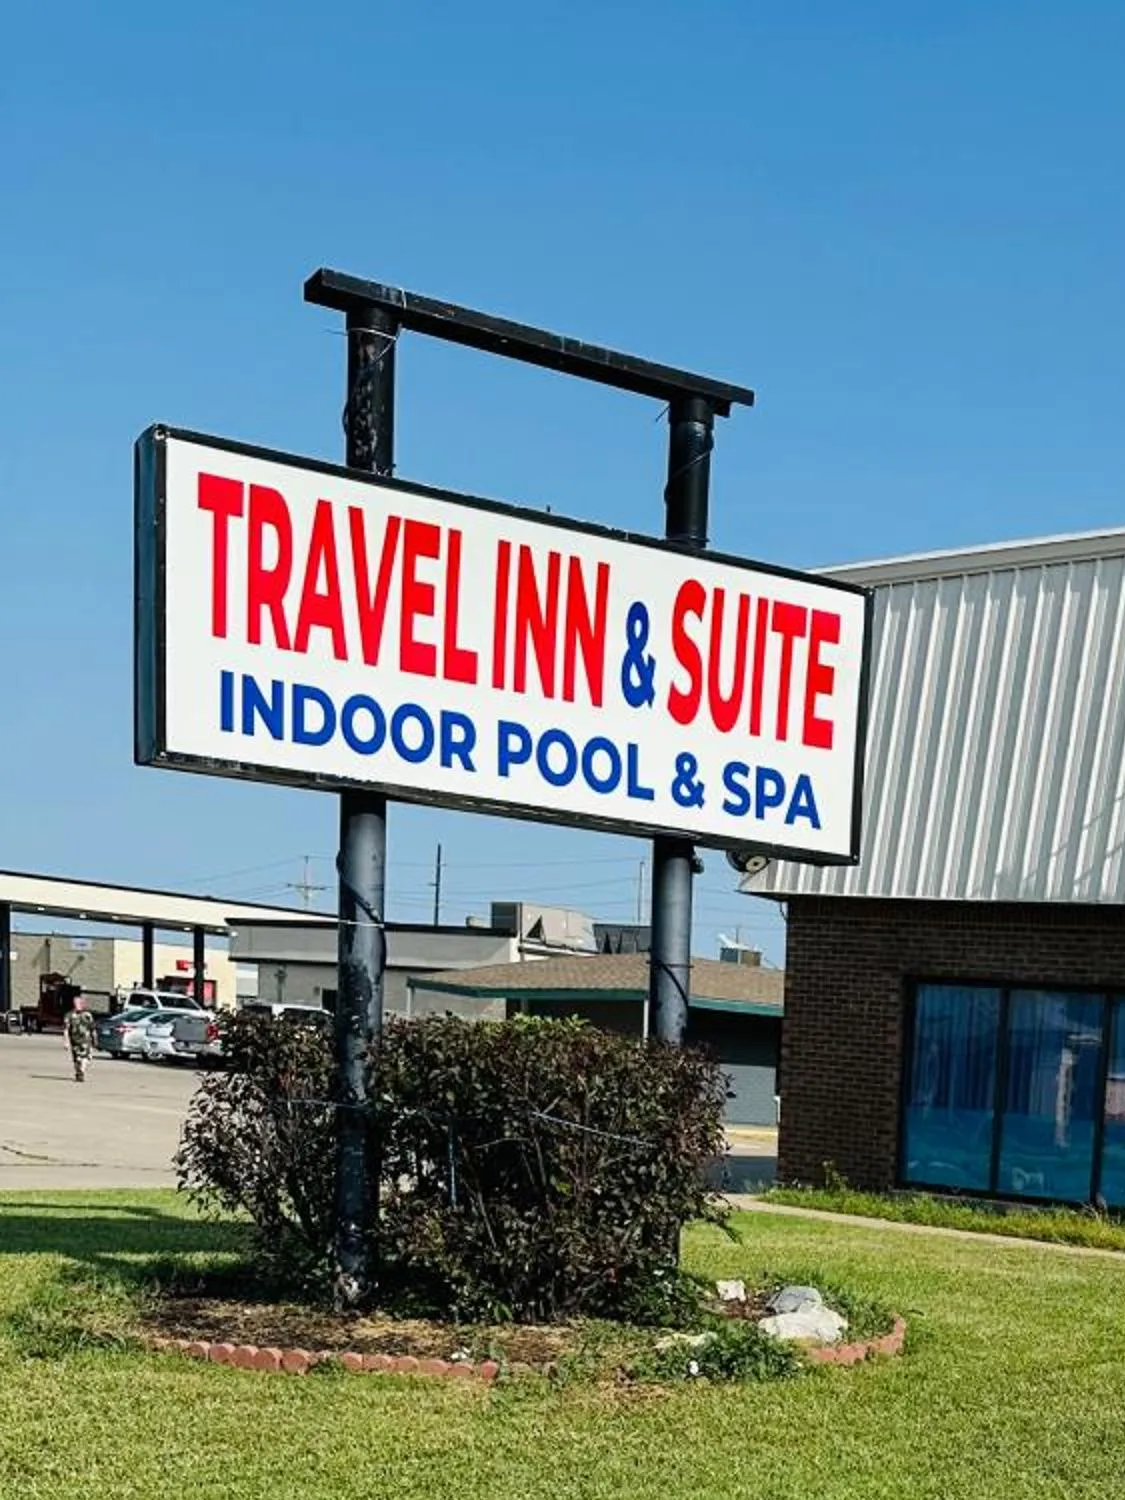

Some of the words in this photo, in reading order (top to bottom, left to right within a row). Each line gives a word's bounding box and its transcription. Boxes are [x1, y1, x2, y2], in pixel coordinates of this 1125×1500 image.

[197, 472, 479, 685] TRAVEL
[491, 539, 611, 708] INN
[621, 602, 656, 709] &
[666, 579, 841, 750] SUITE
[220, 671, 476, 772] INDOOR
[498, 720, 655, 801] POOL
[671, 752, 705, 808] &
[722, 761, 821, 829] SPA
